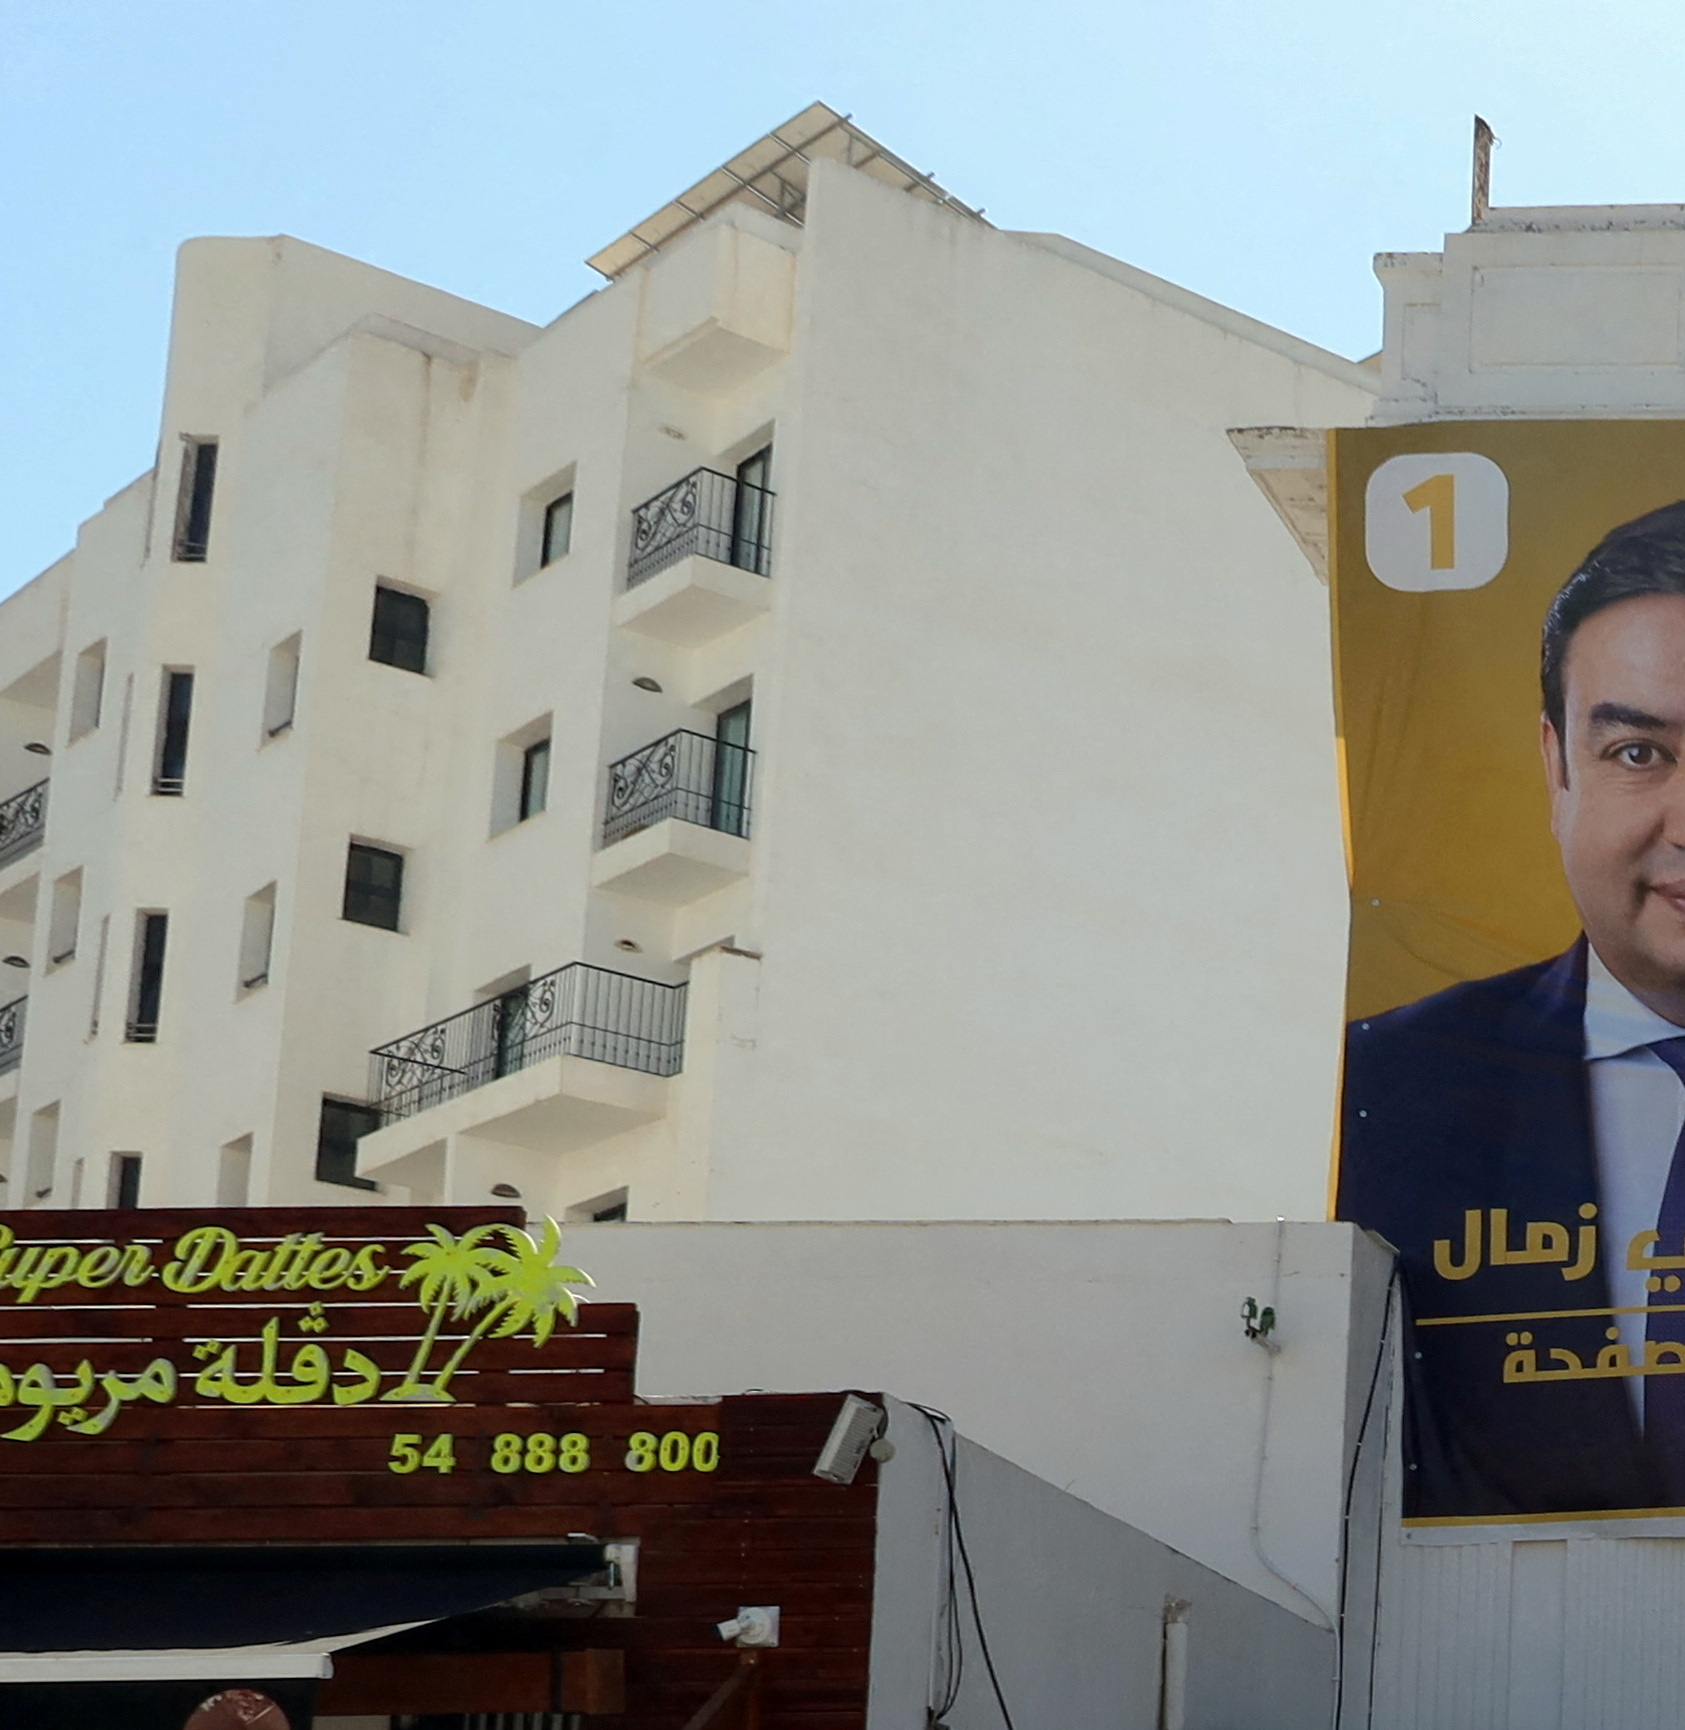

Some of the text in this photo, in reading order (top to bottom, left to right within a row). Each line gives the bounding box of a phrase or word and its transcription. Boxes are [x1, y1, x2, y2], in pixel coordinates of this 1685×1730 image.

[1402, 475, 1454, 569] 1
[161, 1226, 391, 1294] Dattes
[1432, 1202, 1598, 1282] زمال
[387, 1431, 720, 1474] 54 888 800
